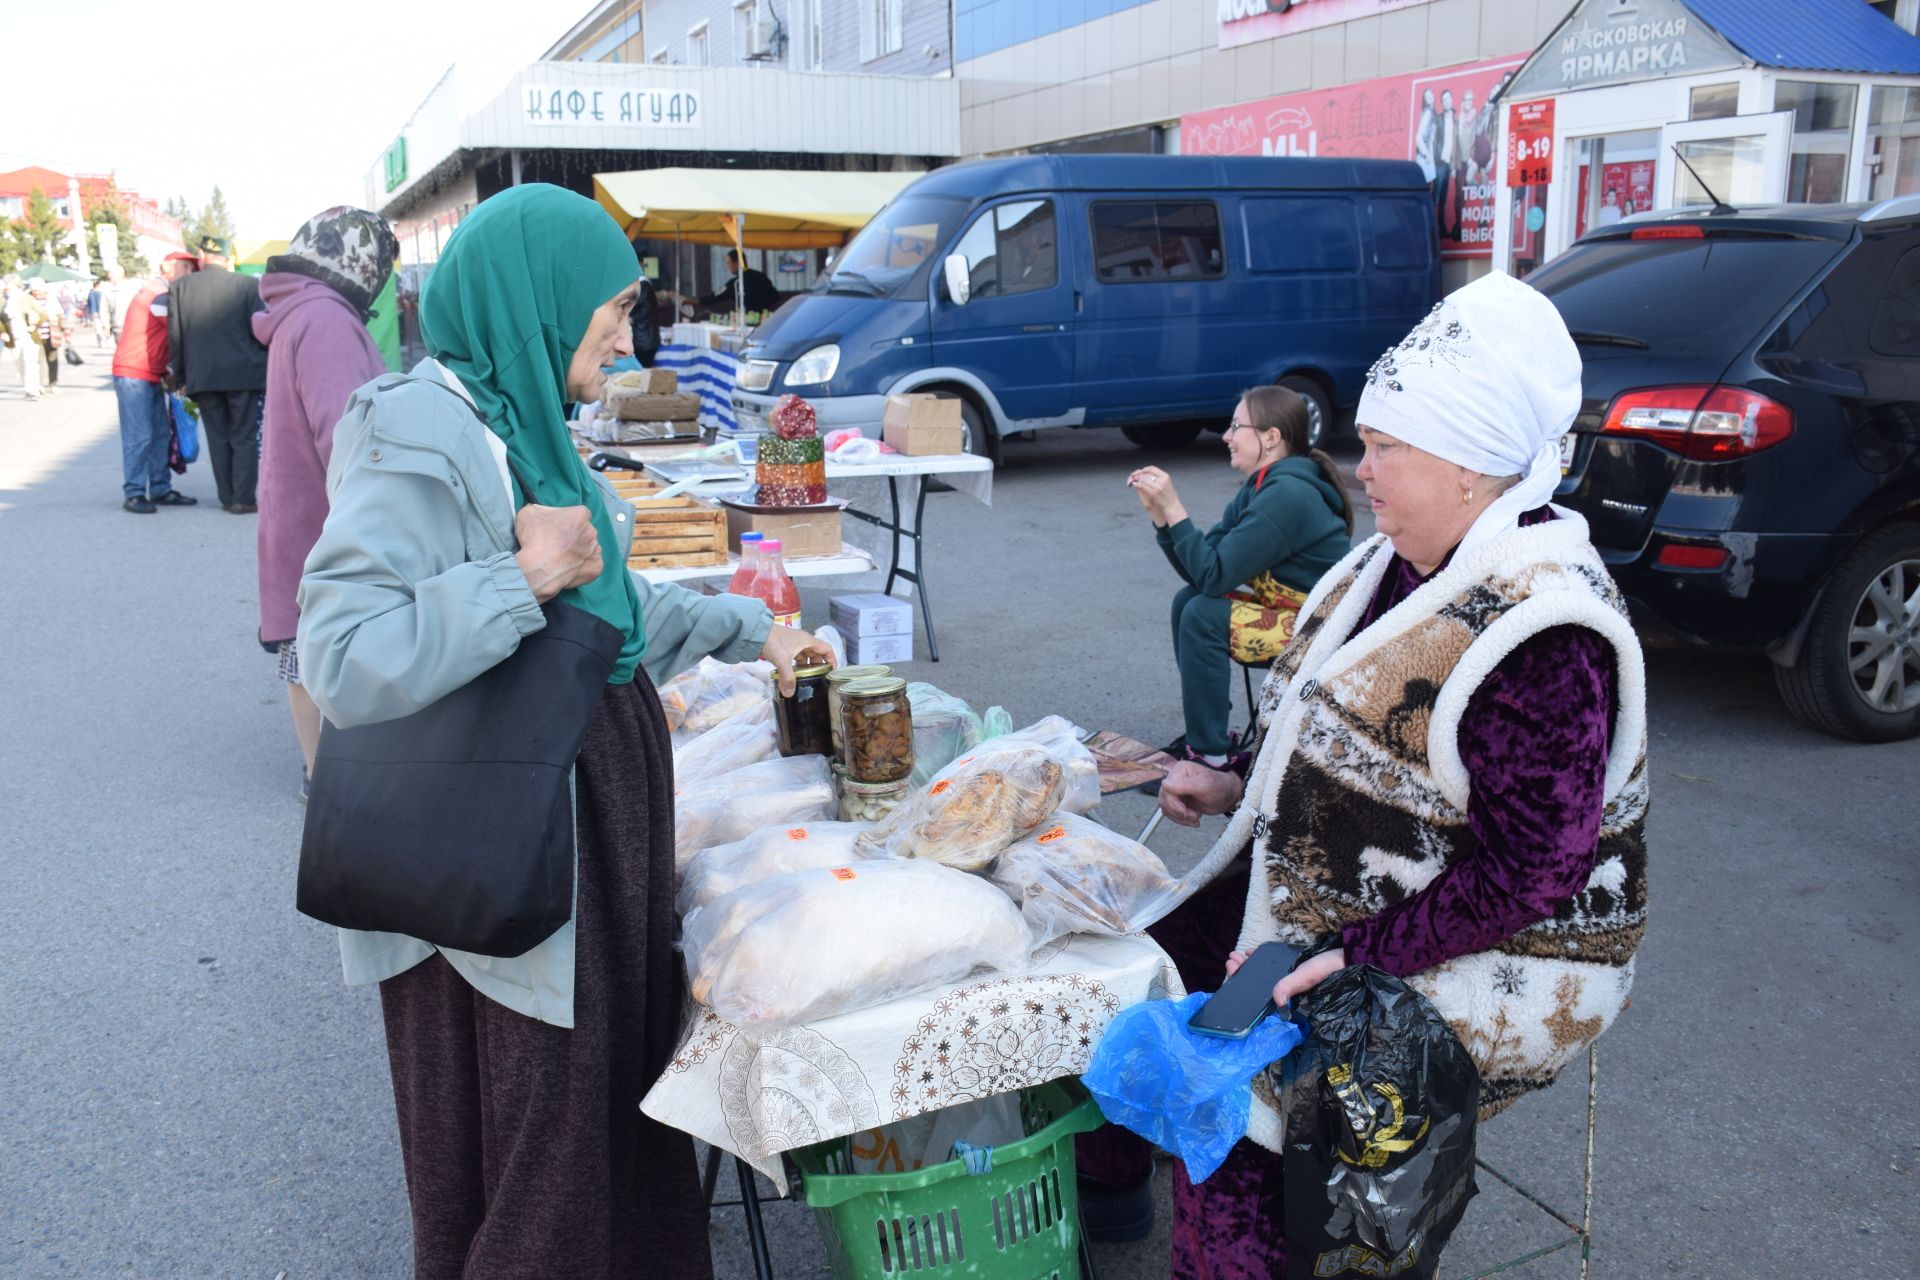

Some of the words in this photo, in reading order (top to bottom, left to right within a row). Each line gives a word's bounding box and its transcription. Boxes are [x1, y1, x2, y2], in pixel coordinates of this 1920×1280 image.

[1561, 41, 1687, 81] ЯРМАРКА
[527, 89, 604, 121] КАФЕ
[620, 92, 698, 123] ЯГУАР
[1262, 131, 1317, 157] МЫ
[1517, 136, 1550, 160] 8-19
[1520, 167, 1547, 183] 8-18
[1462, 226, 1495, 243] ВЫБО
[1602, 499, 1648, 514] RENAULT
